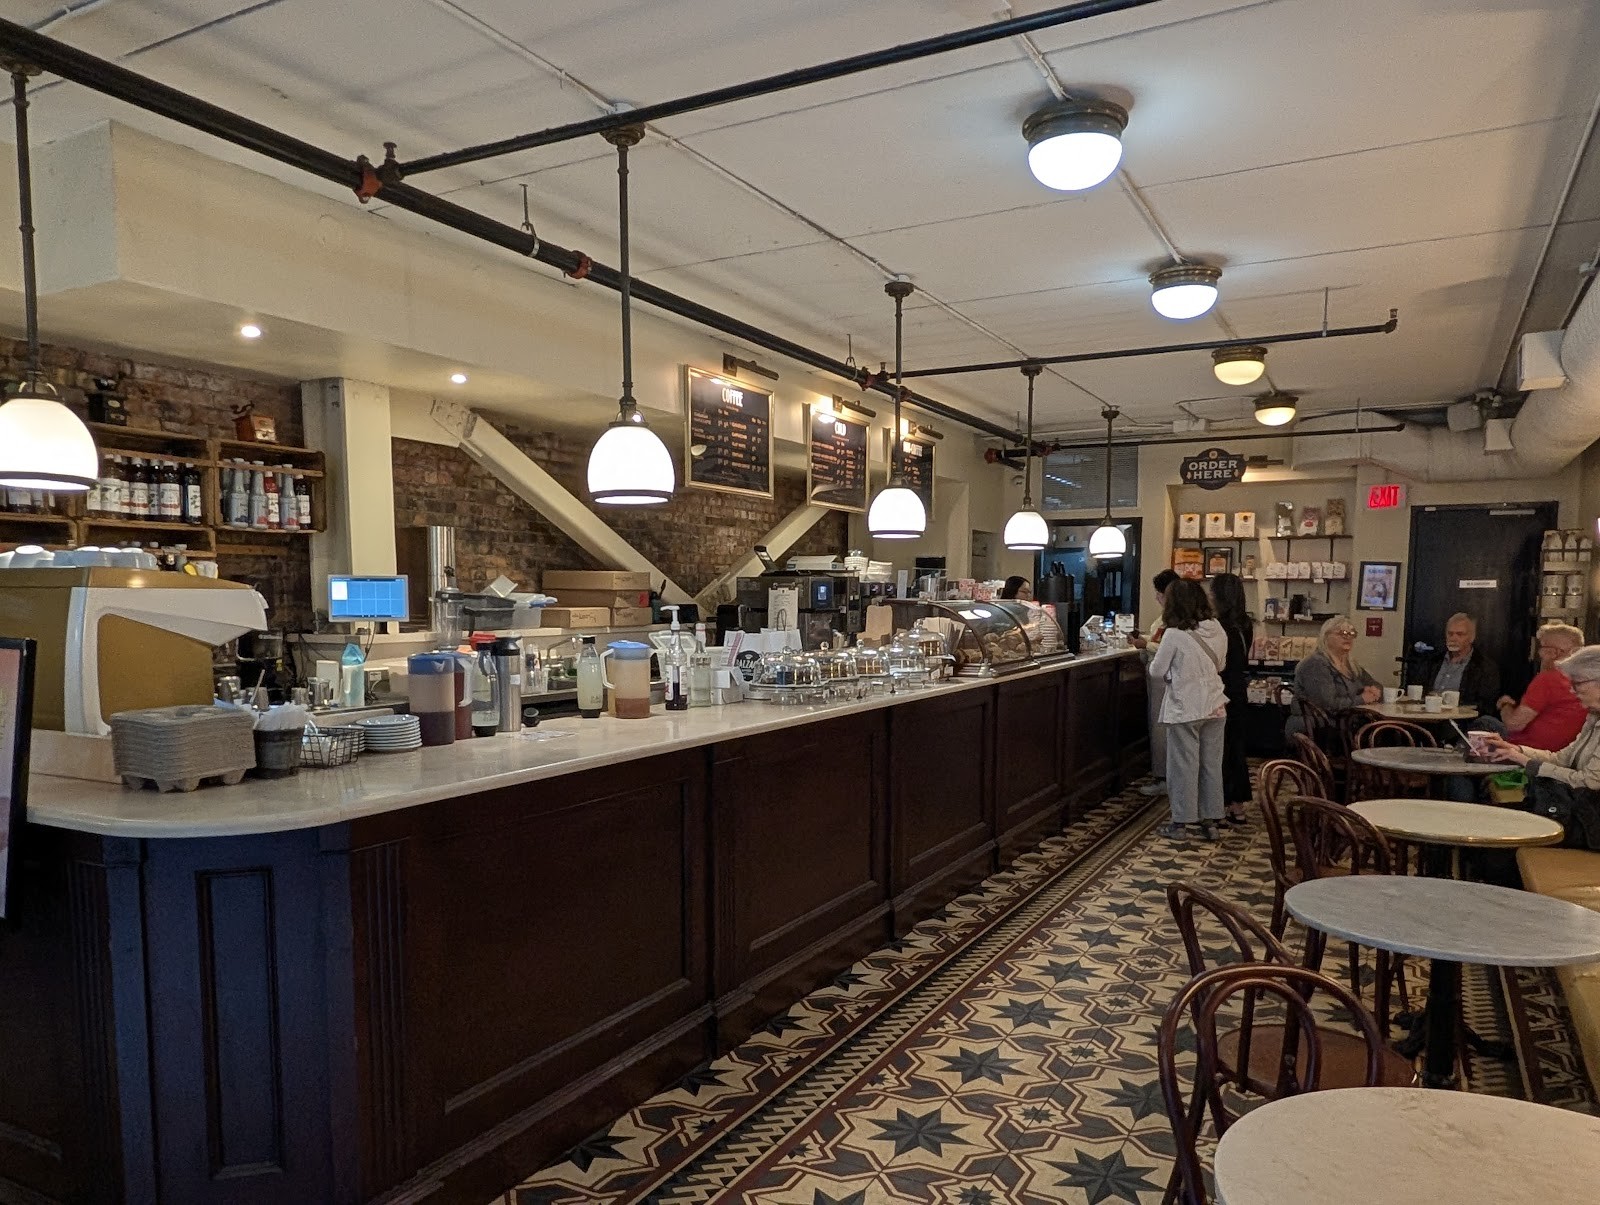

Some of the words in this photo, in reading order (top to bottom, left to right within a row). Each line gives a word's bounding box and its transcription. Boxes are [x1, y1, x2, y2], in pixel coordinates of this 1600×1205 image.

[722, 387, 743, 408] COFFEE
[1189, 460, 1238, 470] ORDER
[1193, 469, 1232, 480] HERE
[1370, 486, 1400, 508] EXIT
